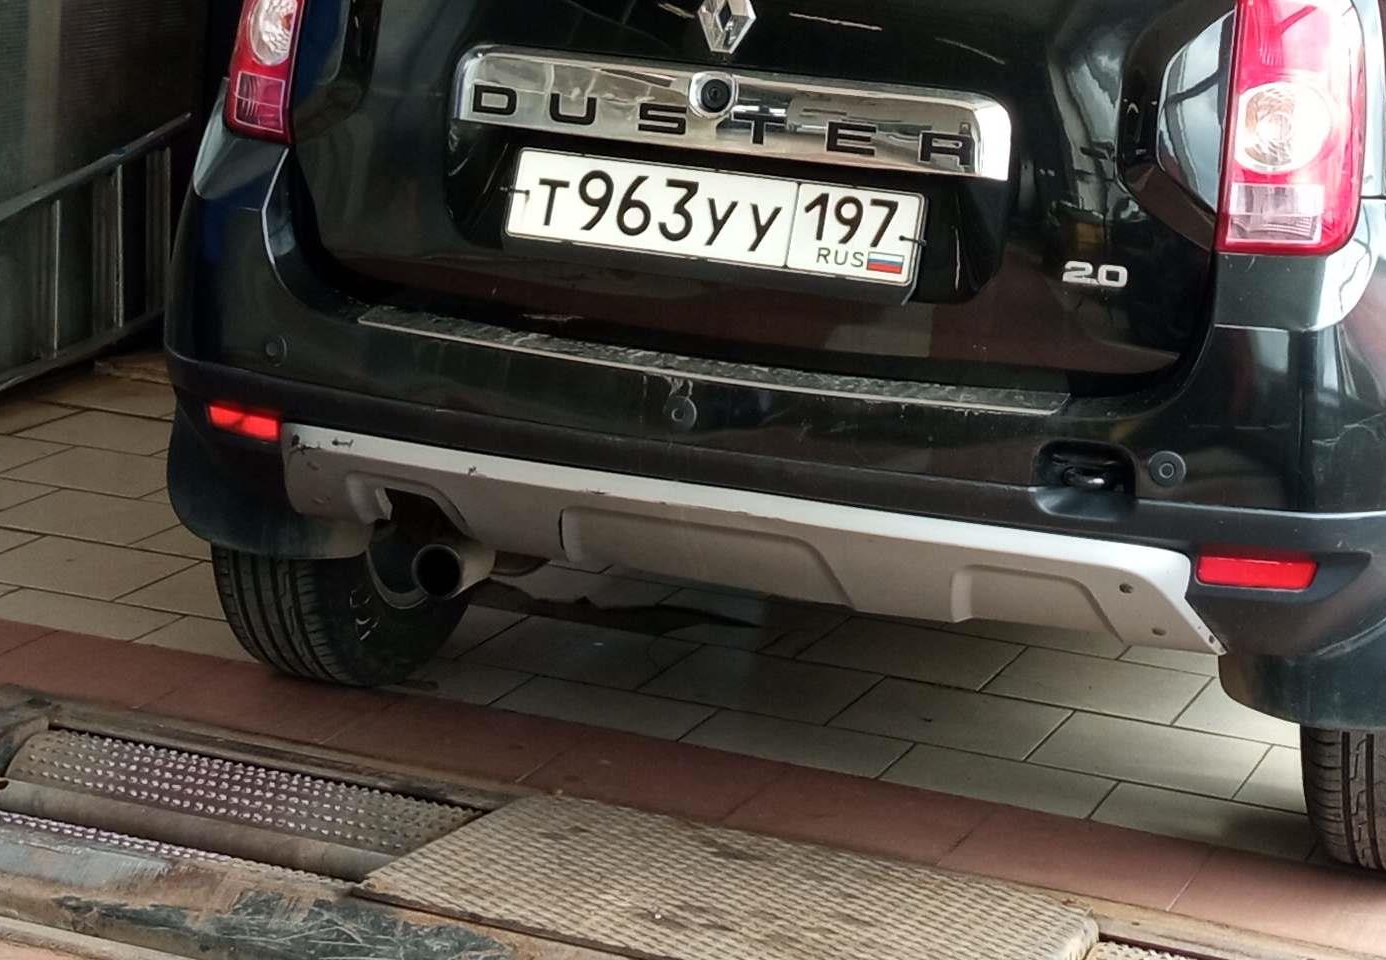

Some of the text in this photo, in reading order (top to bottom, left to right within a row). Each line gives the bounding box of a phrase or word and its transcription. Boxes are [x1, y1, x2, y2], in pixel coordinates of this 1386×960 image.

[473, 84, 975, 166] DUSTER
[538, 169, 900, 252] Т963УУ 197
[816, 247, 865, 269] RUS
